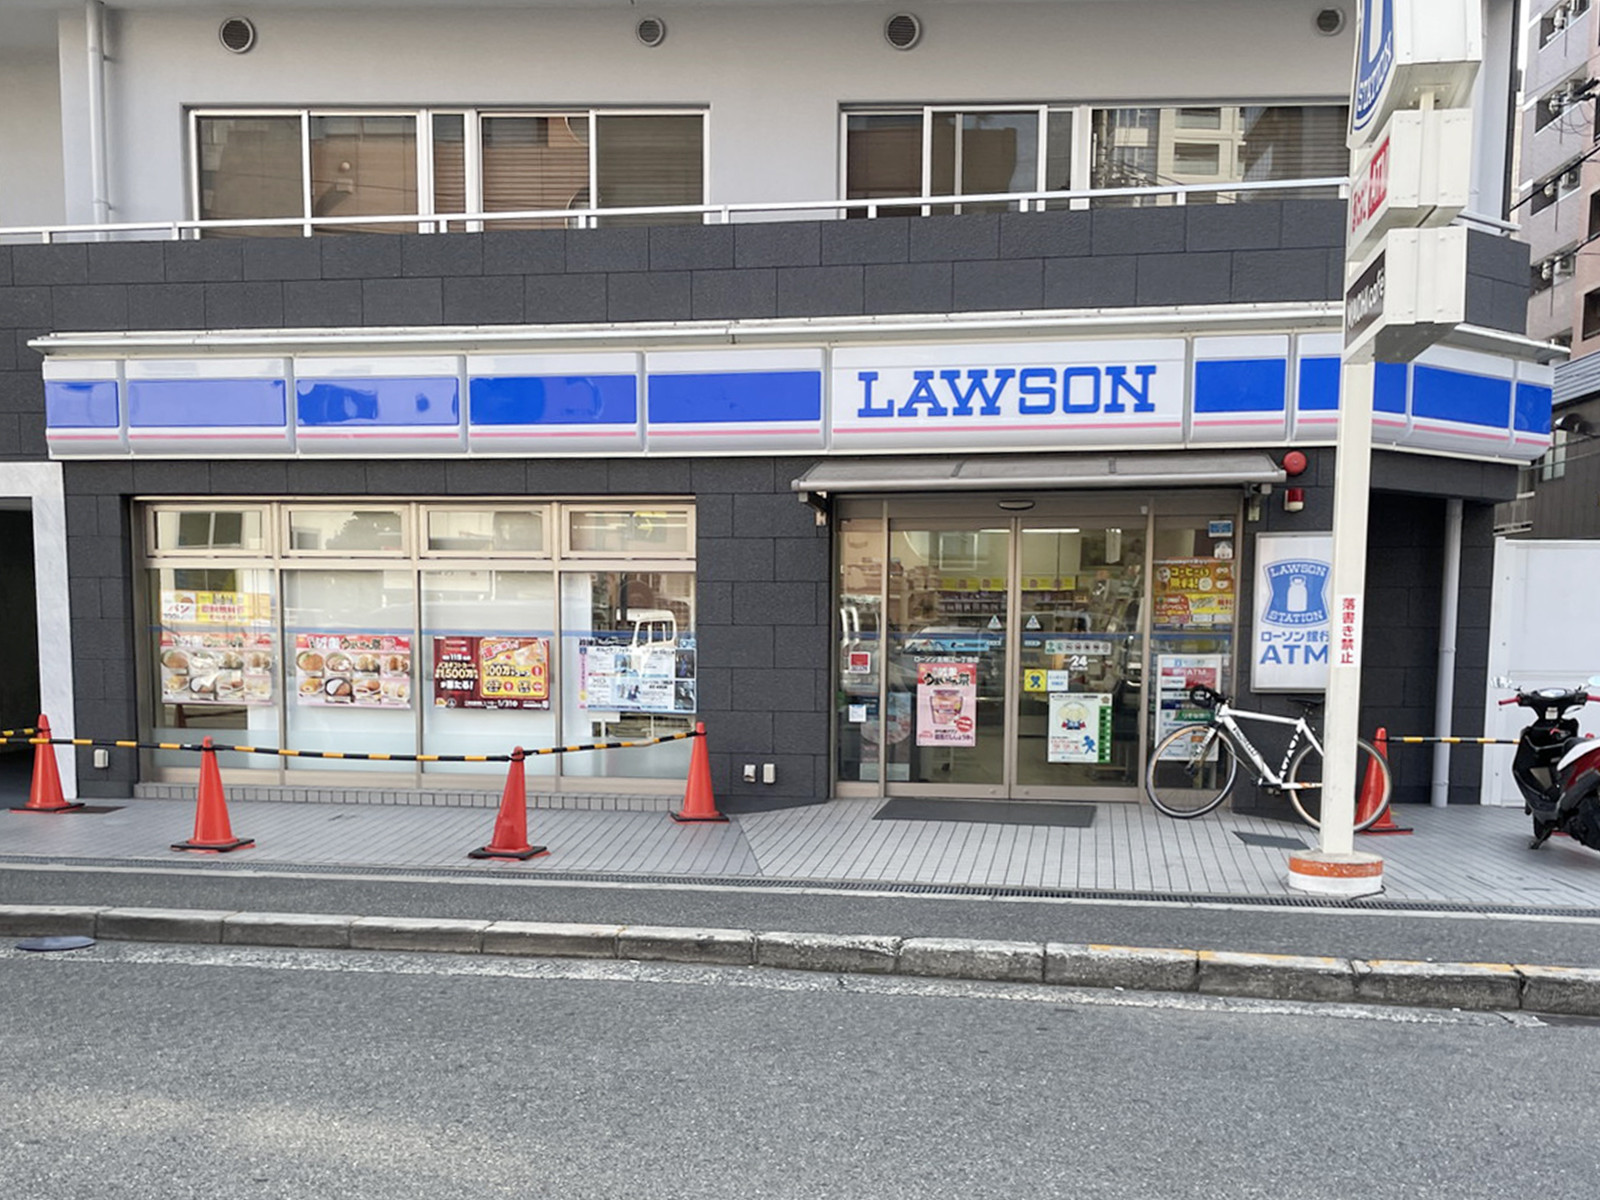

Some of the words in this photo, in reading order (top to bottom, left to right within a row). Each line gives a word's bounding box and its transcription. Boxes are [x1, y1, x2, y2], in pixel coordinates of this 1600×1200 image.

[857, 365, 1157, 418] LAWSON
[1269, 563, 1327, 577] LAWSON
[1268, 610, 1324, 624] STATION
[1261, 631, 1329, 642] ローソン銀行
[1340, 597, 1356, 664] 落書き禁止
[1069, 655, 1088, 667] 24
[1260, 644, 1328, 665] ATM
